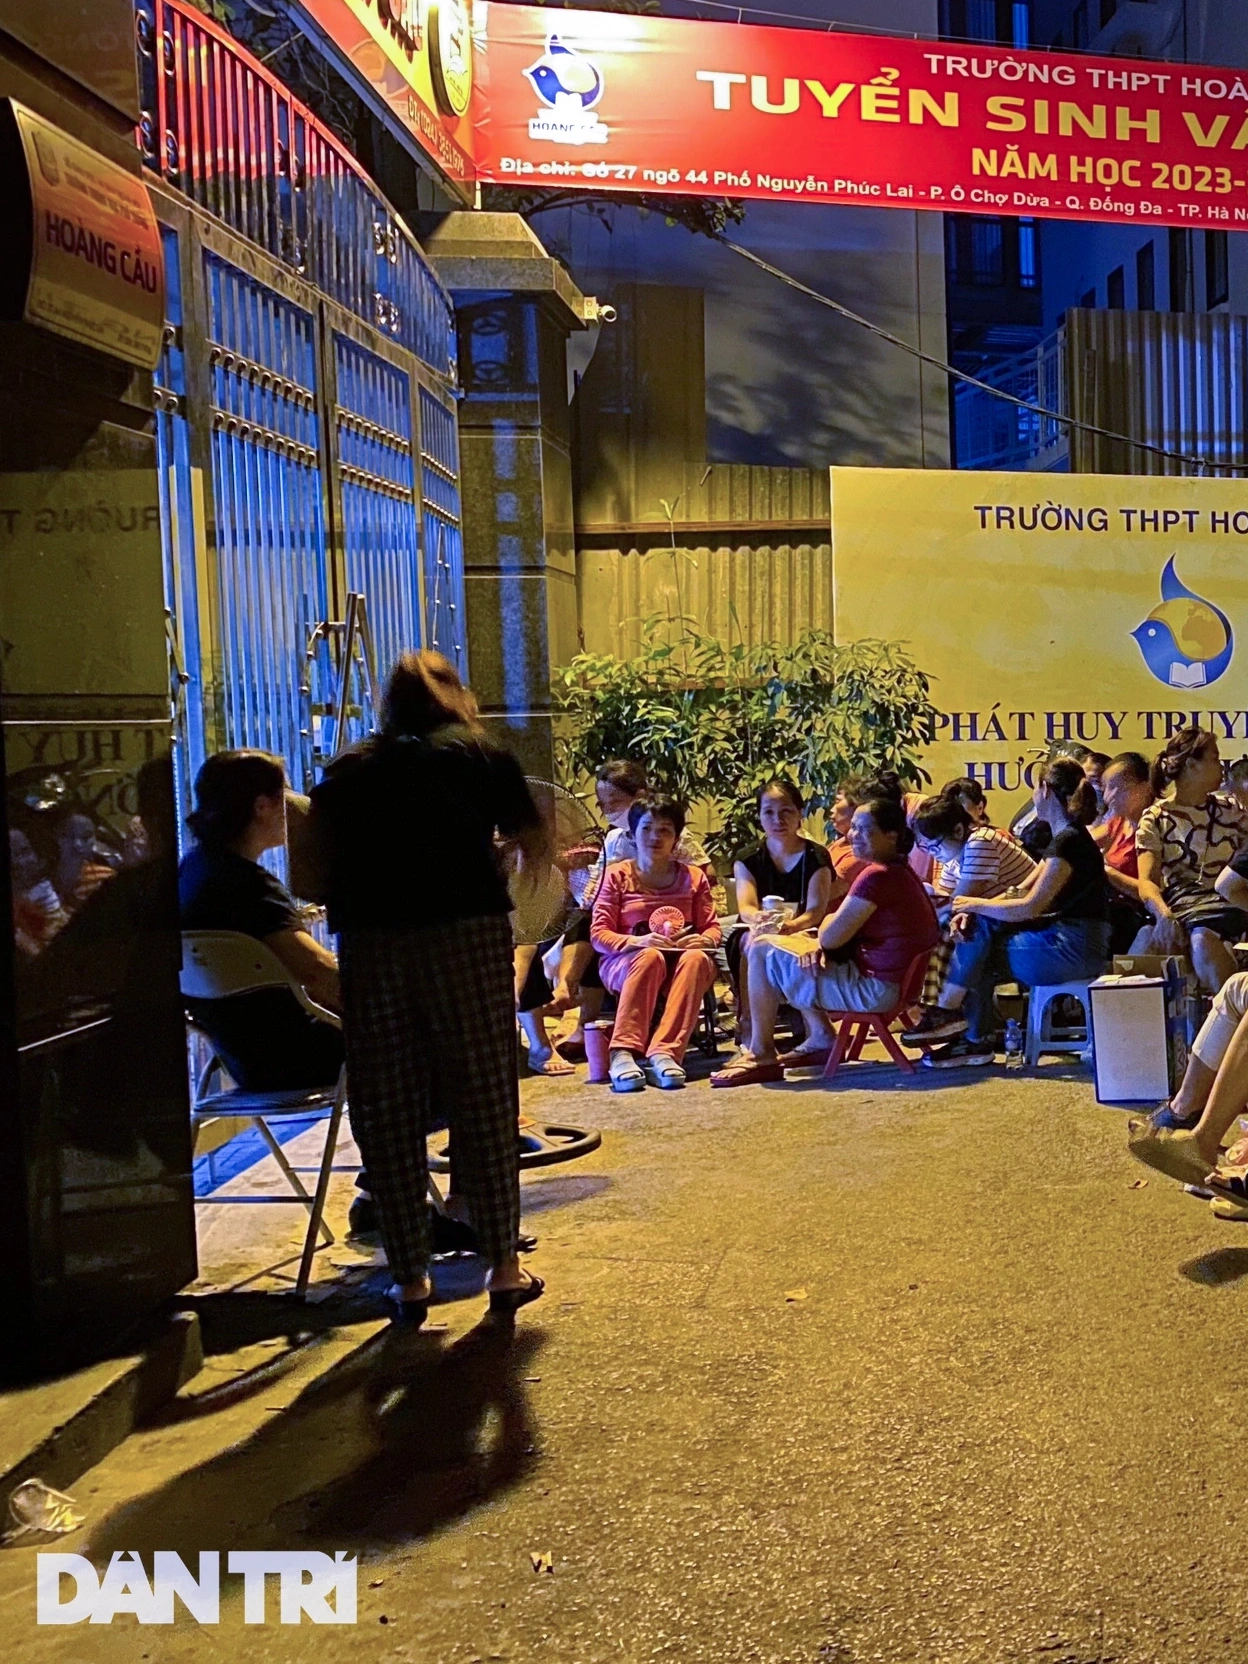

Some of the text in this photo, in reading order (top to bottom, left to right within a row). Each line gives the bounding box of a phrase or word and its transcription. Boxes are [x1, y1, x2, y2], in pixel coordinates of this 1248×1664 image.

[924, 53, 1077, 86] TRƯỜNG
[1086, 67, 1171, 93] THPT
[696, 67, 959, 127] TUYỂN
[986, 95, 1160, 143] SINH
[500, 158, 534, 175] Địa
[613, 165, 638, 180] 27
[643, 167, 680, 185] ngõ
[685, 169, 708, 184] 44
[714, 170, 752, 187] Phố
[757, 173, 828, 194] Nguyễn
[834, 179, 881, 195] Phúc
[886, 183, 914, 198] Lai
[931, 185, 946, 200] P.
[950, 184, 965, 201] Ô
[970, 188, 1009, 206] Chợ
[1013, 190, 1050, 207] Dừa
[1065, 196, 1084, 211] Q.
[1090, 195, 1134, 216] Đống
[1139, 201, 1162, 215] Đa
[1178, 203, 1203, 217] TP.
[1207, 206, 1229, 220] Hà
[972, 144, 1058, 181] NĂM
[1070, 155, 1141, 192] HỌC
[45, 207, 157, 294] HOÀNG CẦU
[973, 502, 1109, 532] TRƯỜNG
[1120, 509, 1200, 533] THPT
[928, 702, 1035, 742] PHÁT
[1043, 711, 1129, 741] HUY
